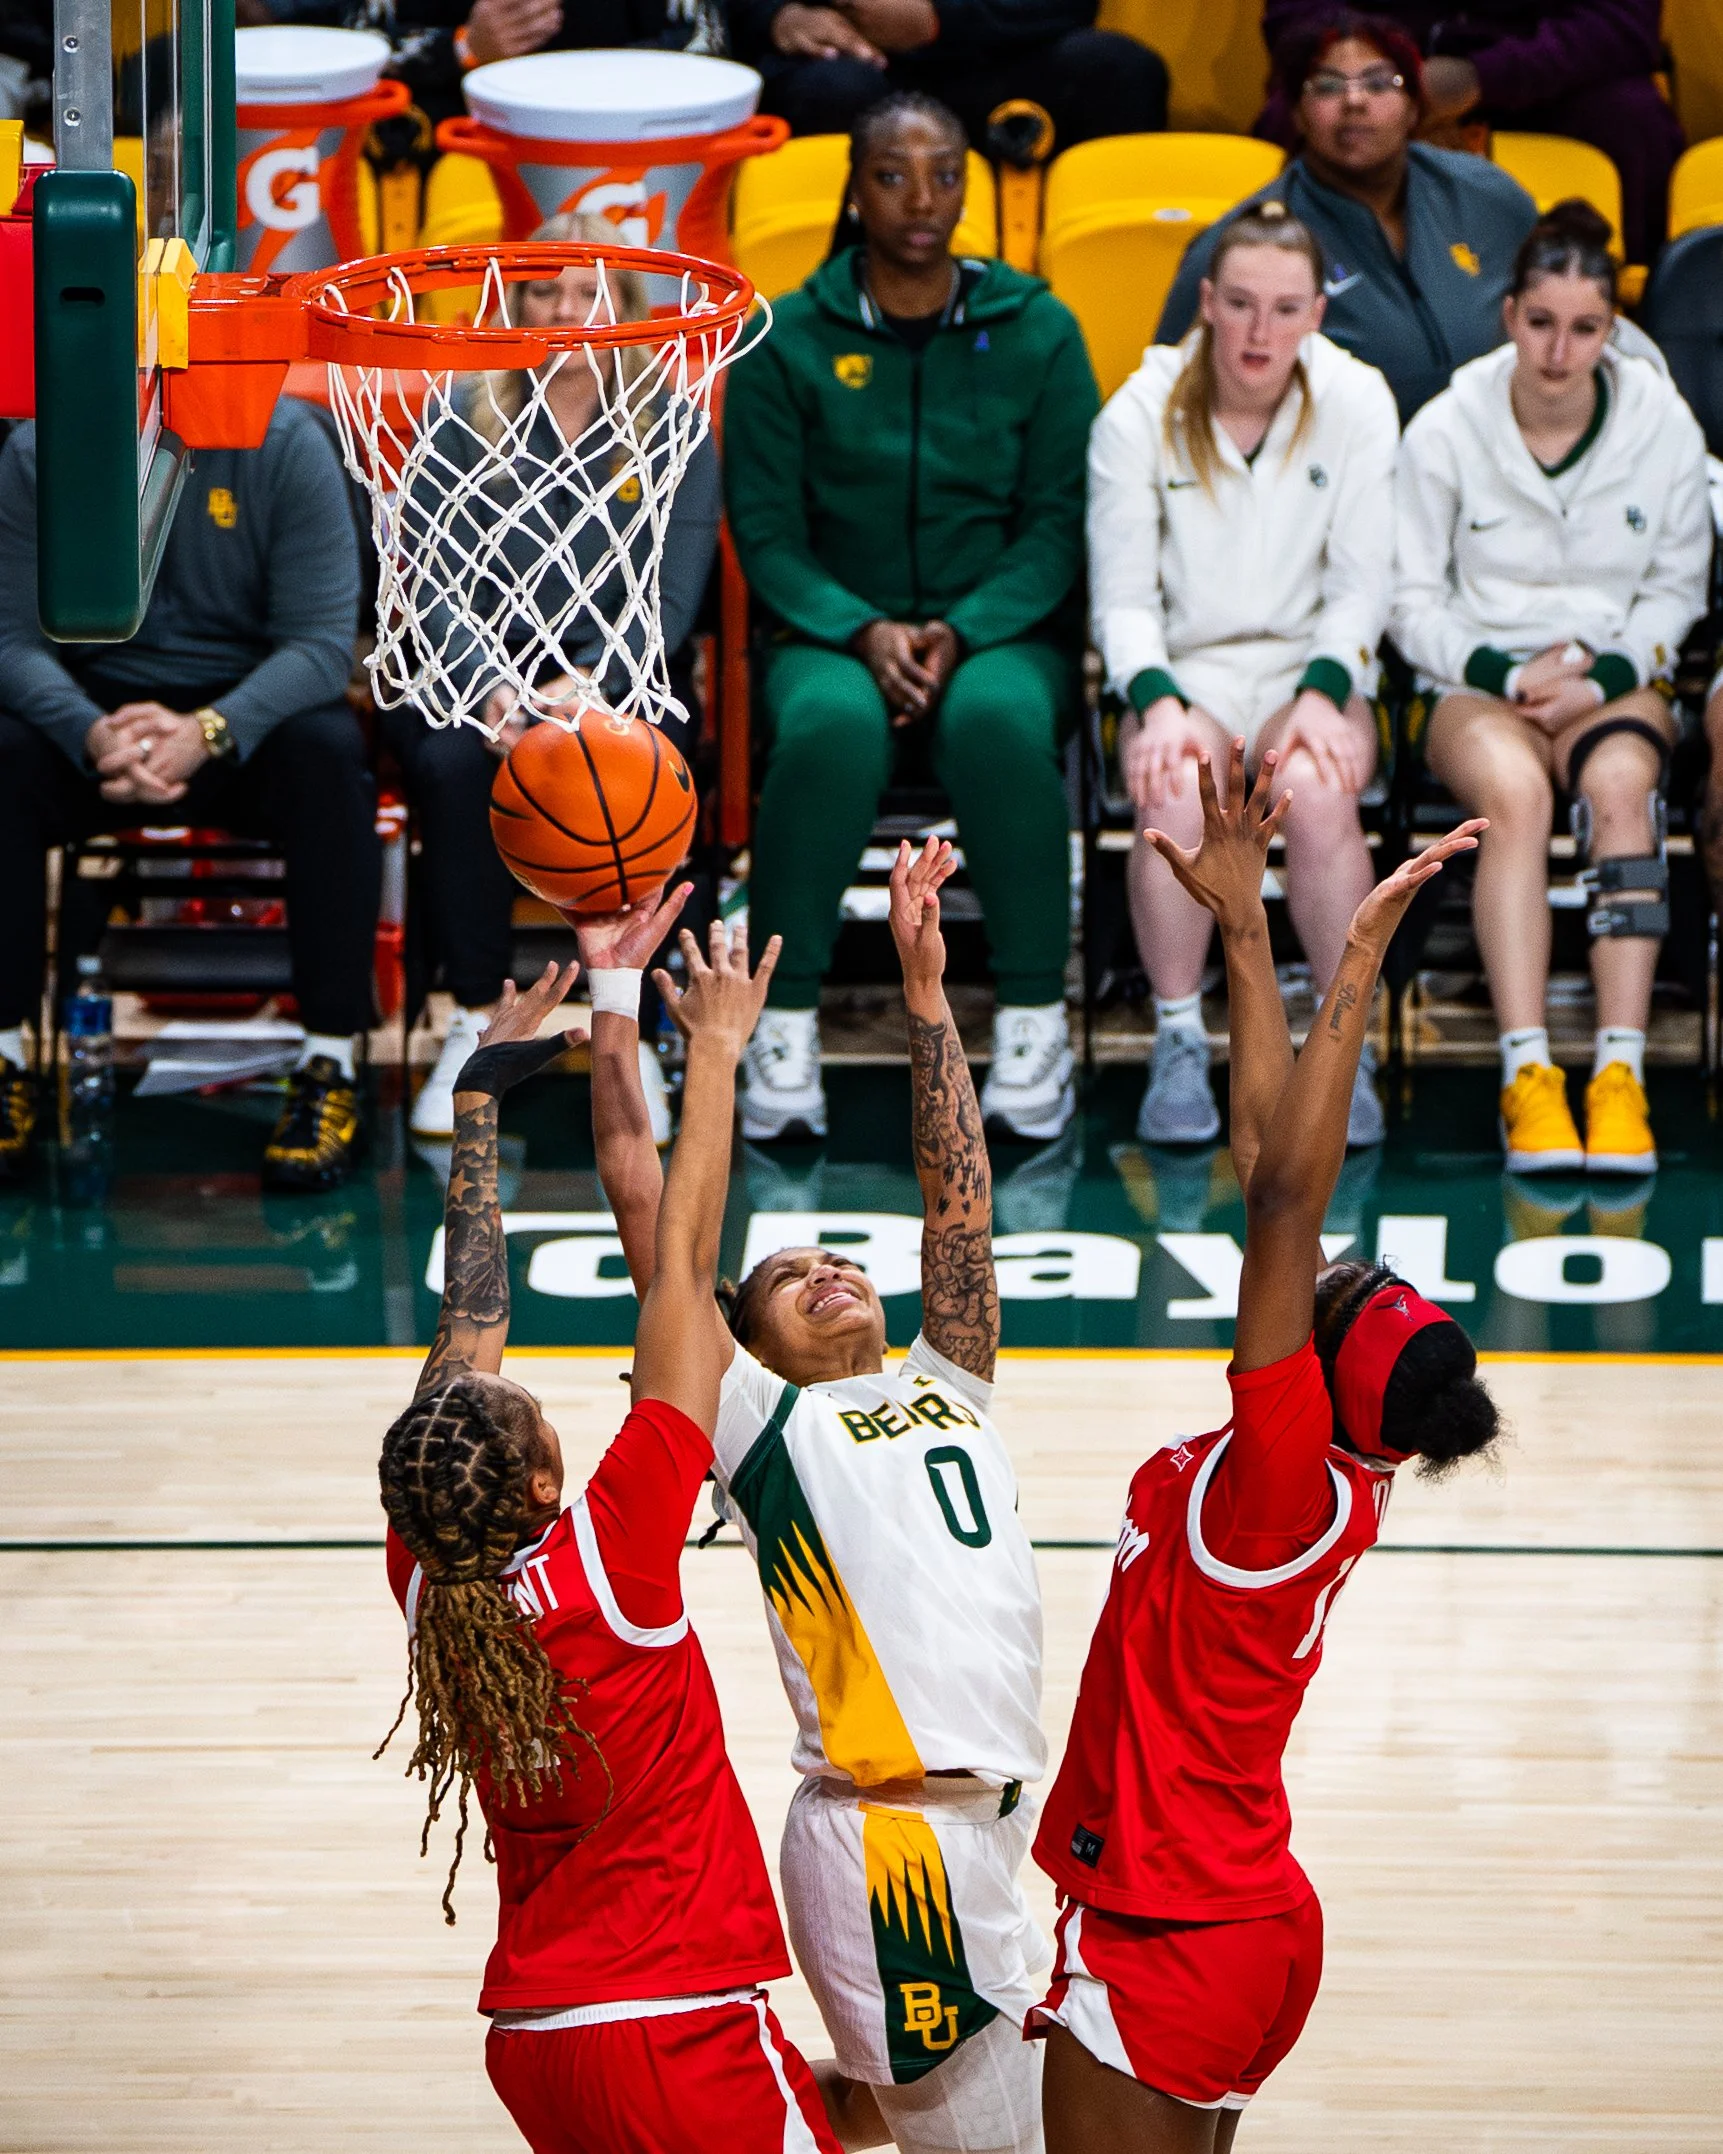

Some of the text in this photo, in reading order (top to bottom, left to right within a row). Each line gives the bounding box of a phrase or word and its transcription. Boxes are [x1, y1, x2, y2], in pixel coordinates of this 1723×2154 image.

[245, 146, 321, 231] G
[425, 1210, 1723, 1319] @Baylo
[924, 1445, 992, 1549] 0
[899, 1982, 959, 2051] BU
